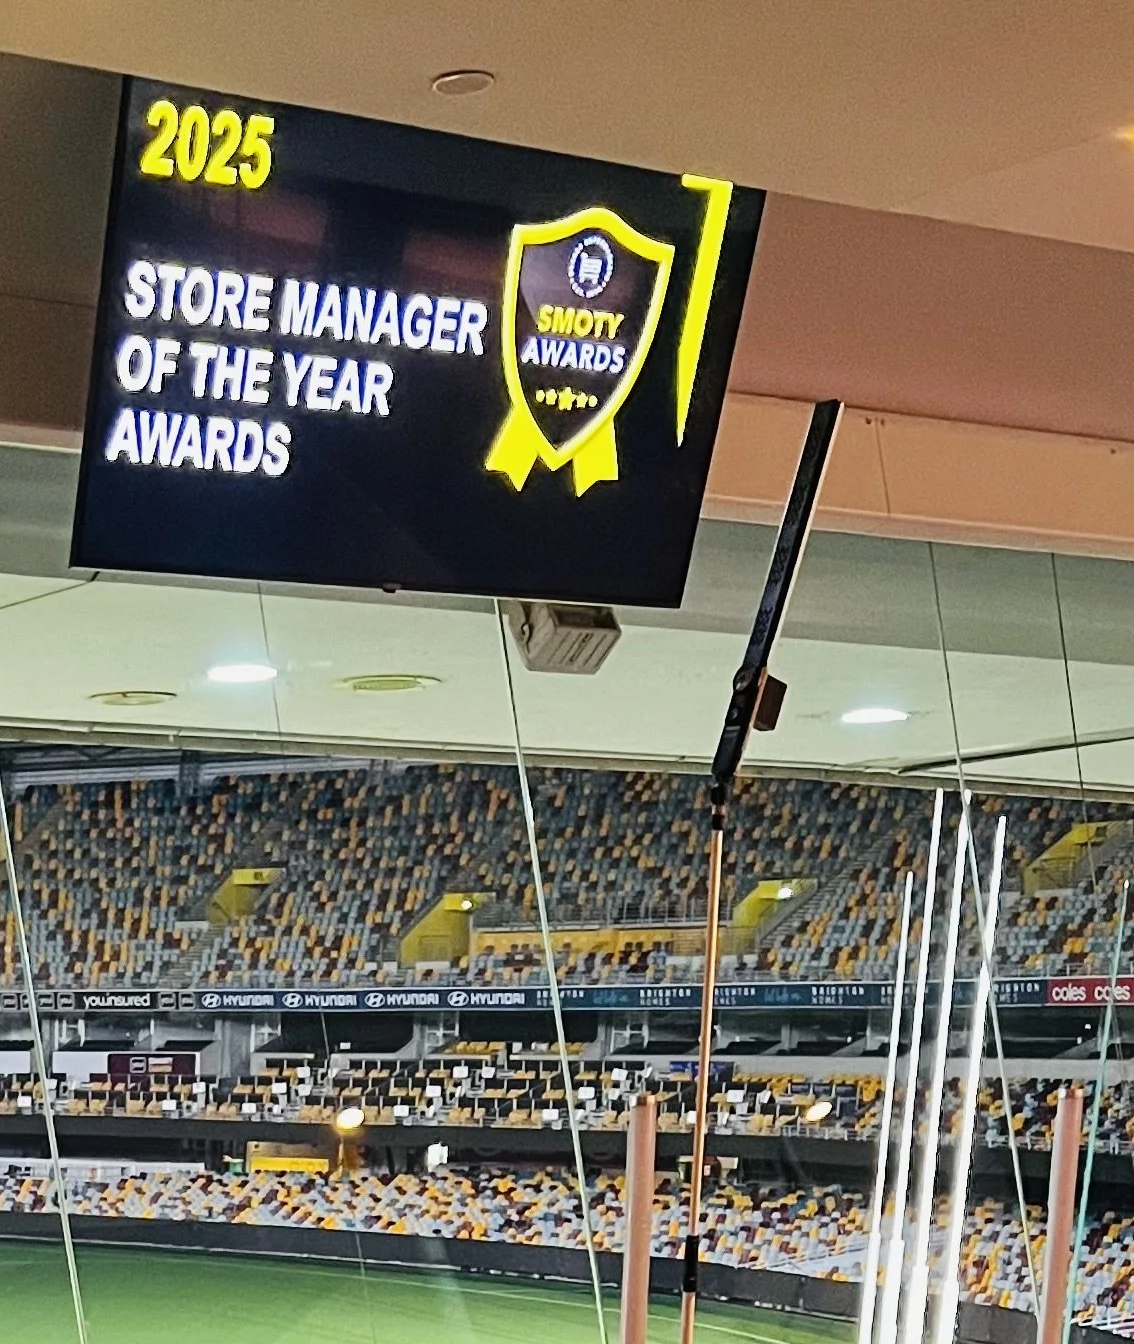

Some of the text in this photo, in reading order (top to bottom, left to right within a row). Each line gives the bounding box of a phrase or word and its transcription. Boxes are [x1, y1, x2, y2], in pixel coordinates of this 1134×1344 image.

[140, 100, 275, 189] 2025
[124, 260, 488, 357] STORE MANAGER
[537, 304, 624, 340] SMOTY
[520, 336, 626, 374] AWARDS
[116, 335, 395, 417] OF THE YEAR
[105, 408, 293, 477] AWARDS
[223, 994, 274, 1006] HYUNDAI
[305, 994, 356, 1006] HYUNDAI
[387, 993, 439, 1005] HYUNDAI
[471, 993, 525, 1005] HYUNDAI
[1052, 982, 1086, 1001] coles
